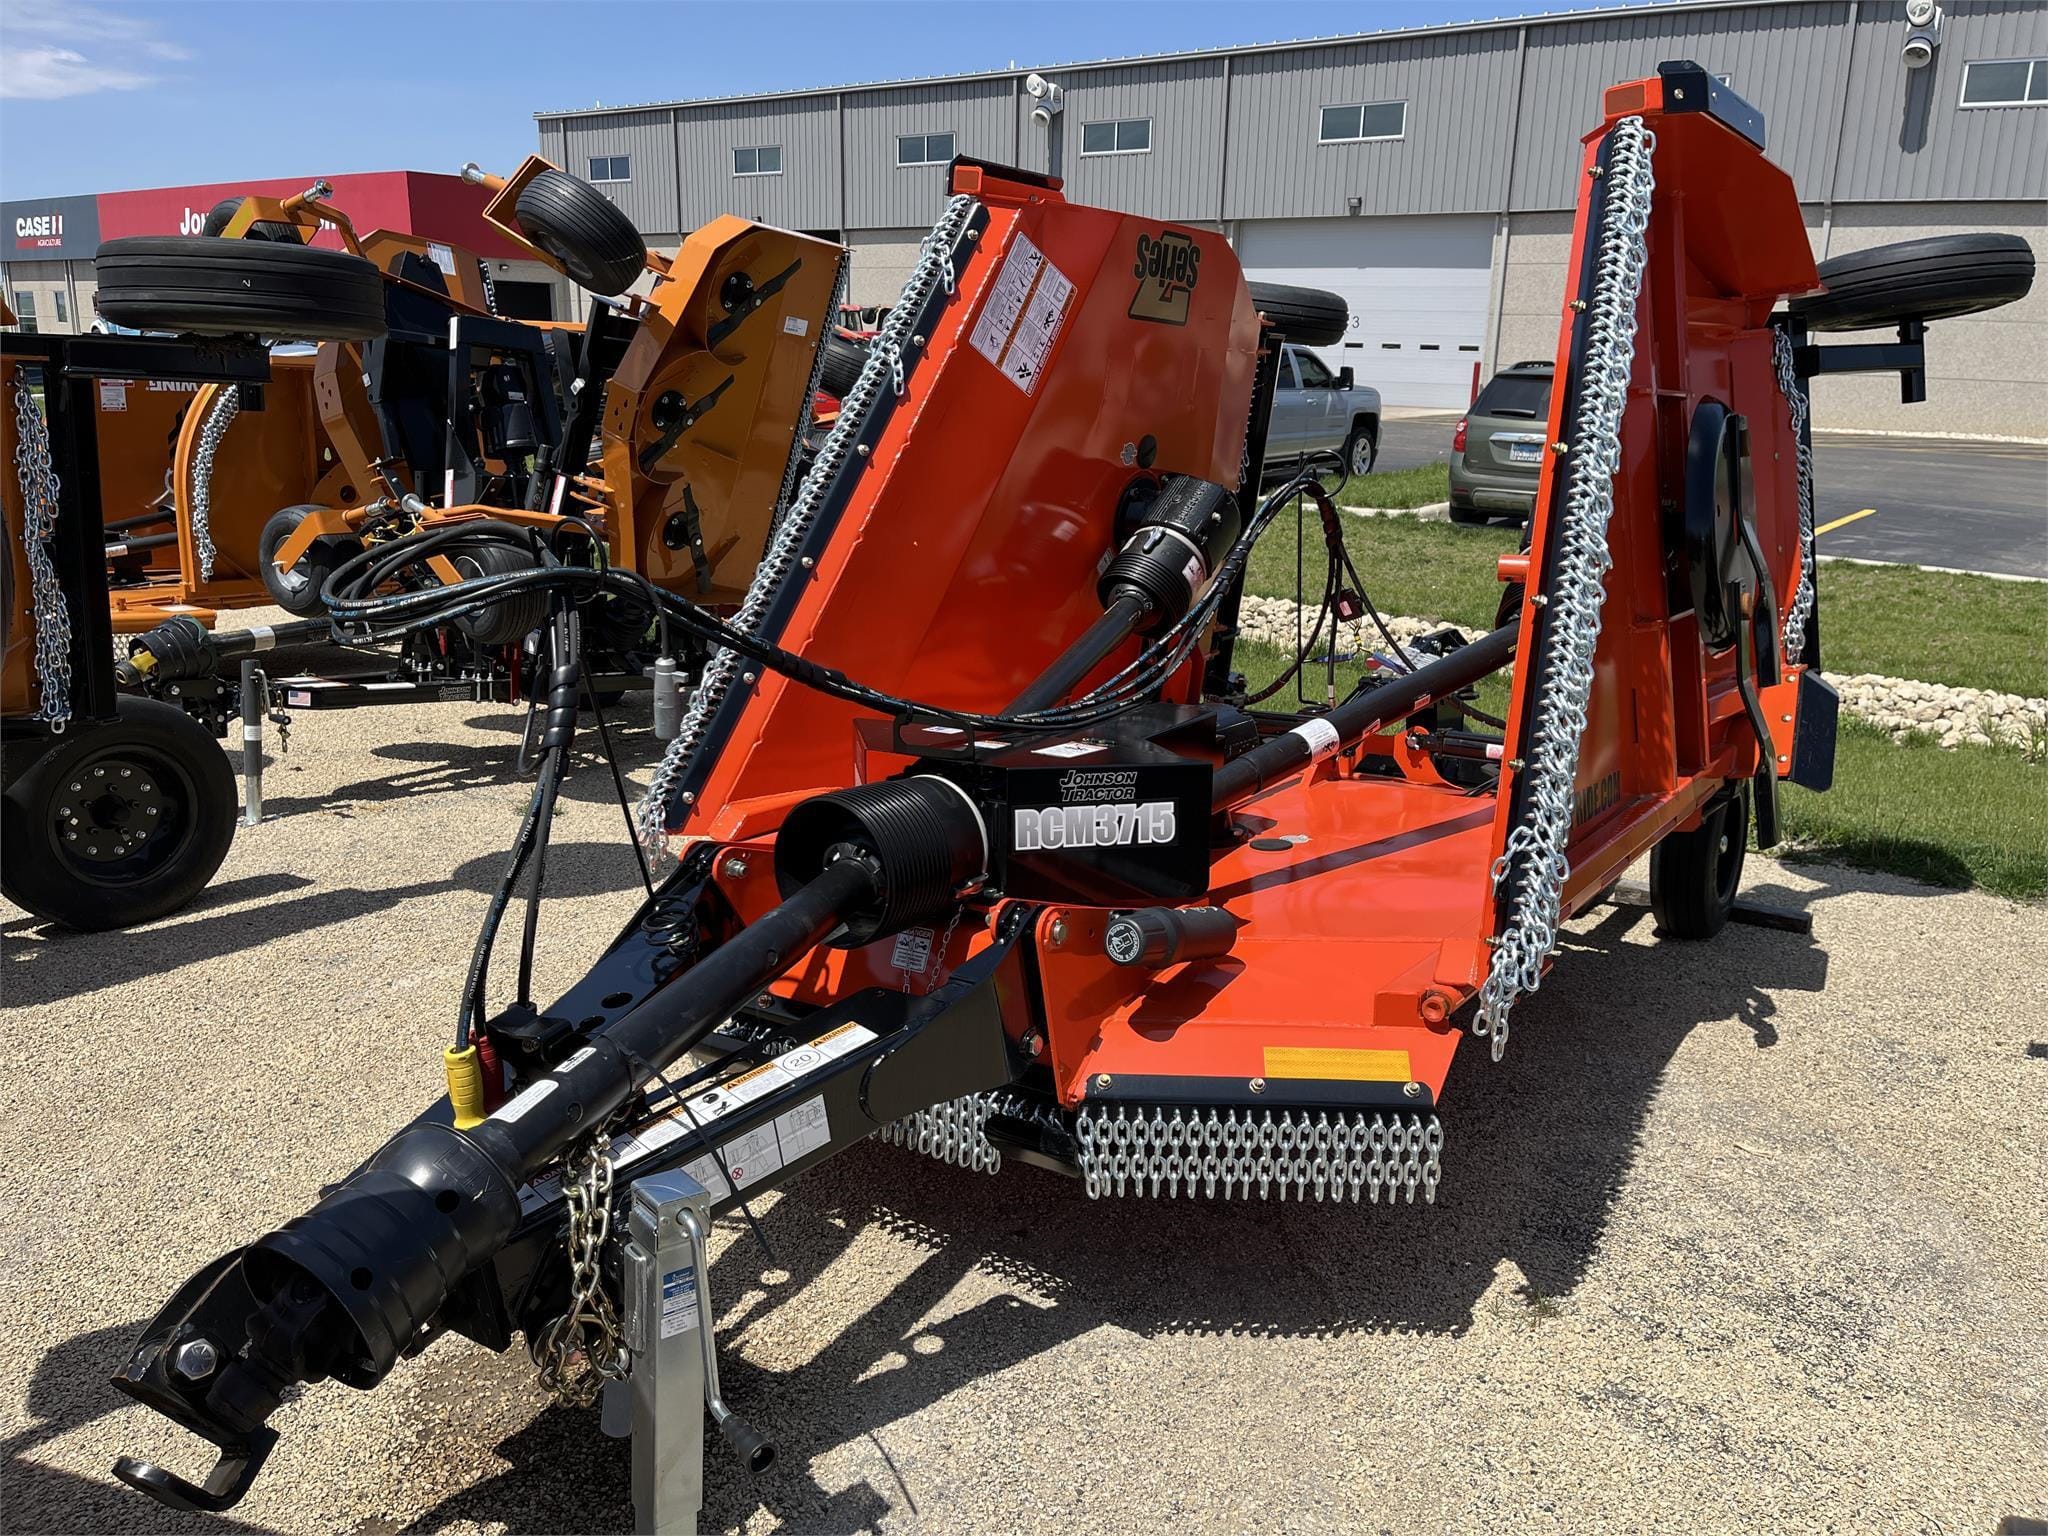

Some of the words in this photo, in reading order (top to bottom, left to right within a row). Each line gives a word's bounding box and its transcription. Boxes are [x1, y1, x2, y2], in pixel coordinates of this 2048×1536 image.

[16, 216, 50, 237] CASE
[1134, 233, 1201, 289] Series
[1352, 315, 1360, 329] 3
[148, 380, 200, 392] WING
[1060, 769, 1137, 787] JOHNSON
[1061, 786, 1136, 802] TRACTOR
[1572, 770, 1621, 827] RIDE.COM
[1015, 802, 1176, 851] RCM3715
[821, 1022, 858, 1041] WARNING
[789, 1053, 812, 1068] 20
[734, 1063, 775, 1085] WARNING
